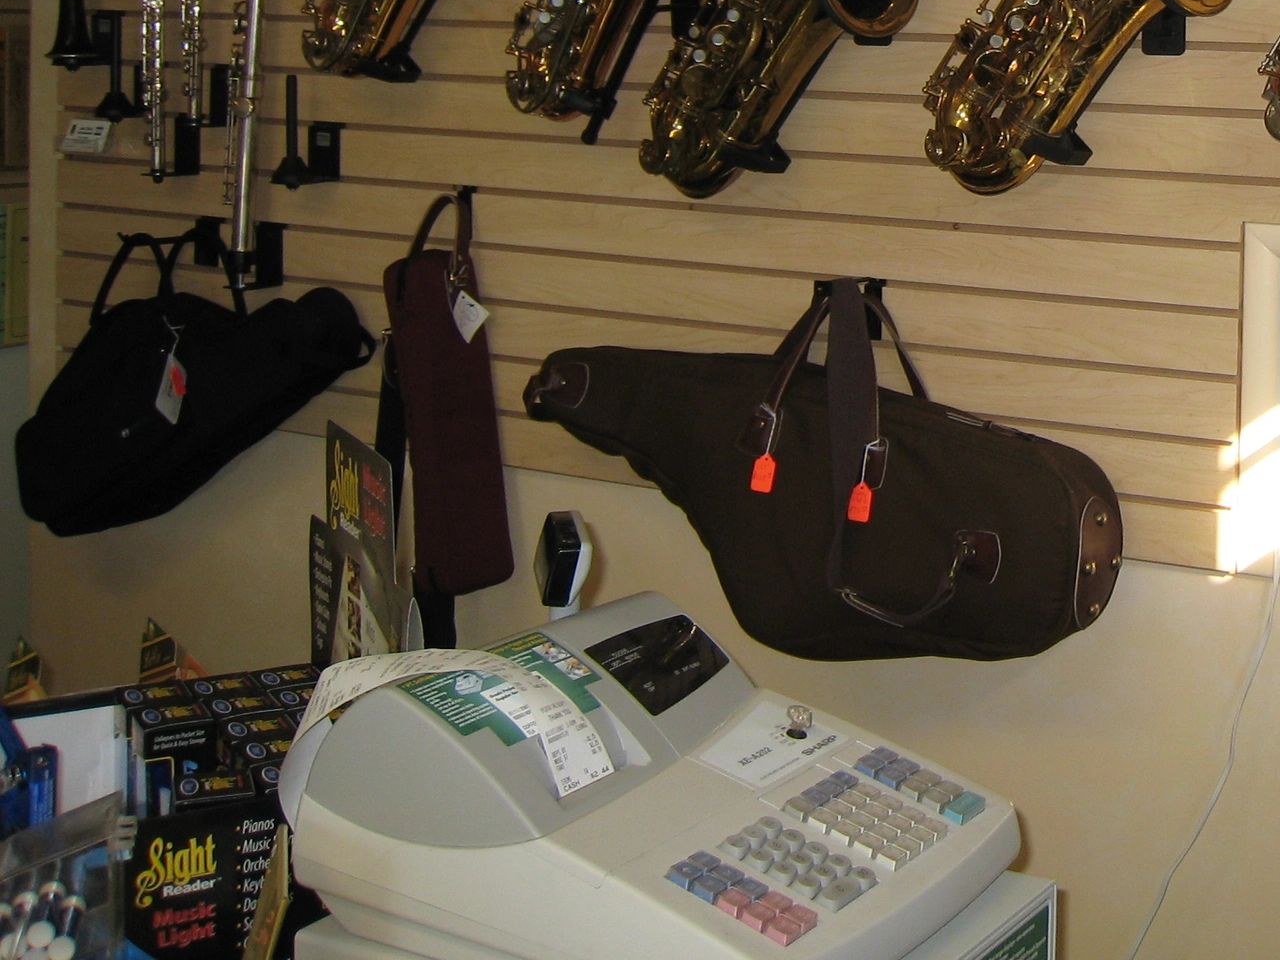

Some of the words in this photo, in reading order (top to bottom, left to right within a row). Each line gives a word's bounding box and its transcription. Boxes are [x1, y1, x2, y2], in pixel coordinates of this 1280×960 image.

[330, 439, 359, 530] Sight
[801, 735, 836, 756] SHARP
[563, 780, 581, 792] CASH
[242, 819, 275, 835] Pianos
[242, 836, 271, 854] Music
[135, 834, 217, 909] Sight
[162, 878, 217, 897] Reader
[152, 901, 217, 928] Music
[156, 921, 217, 950] Light
